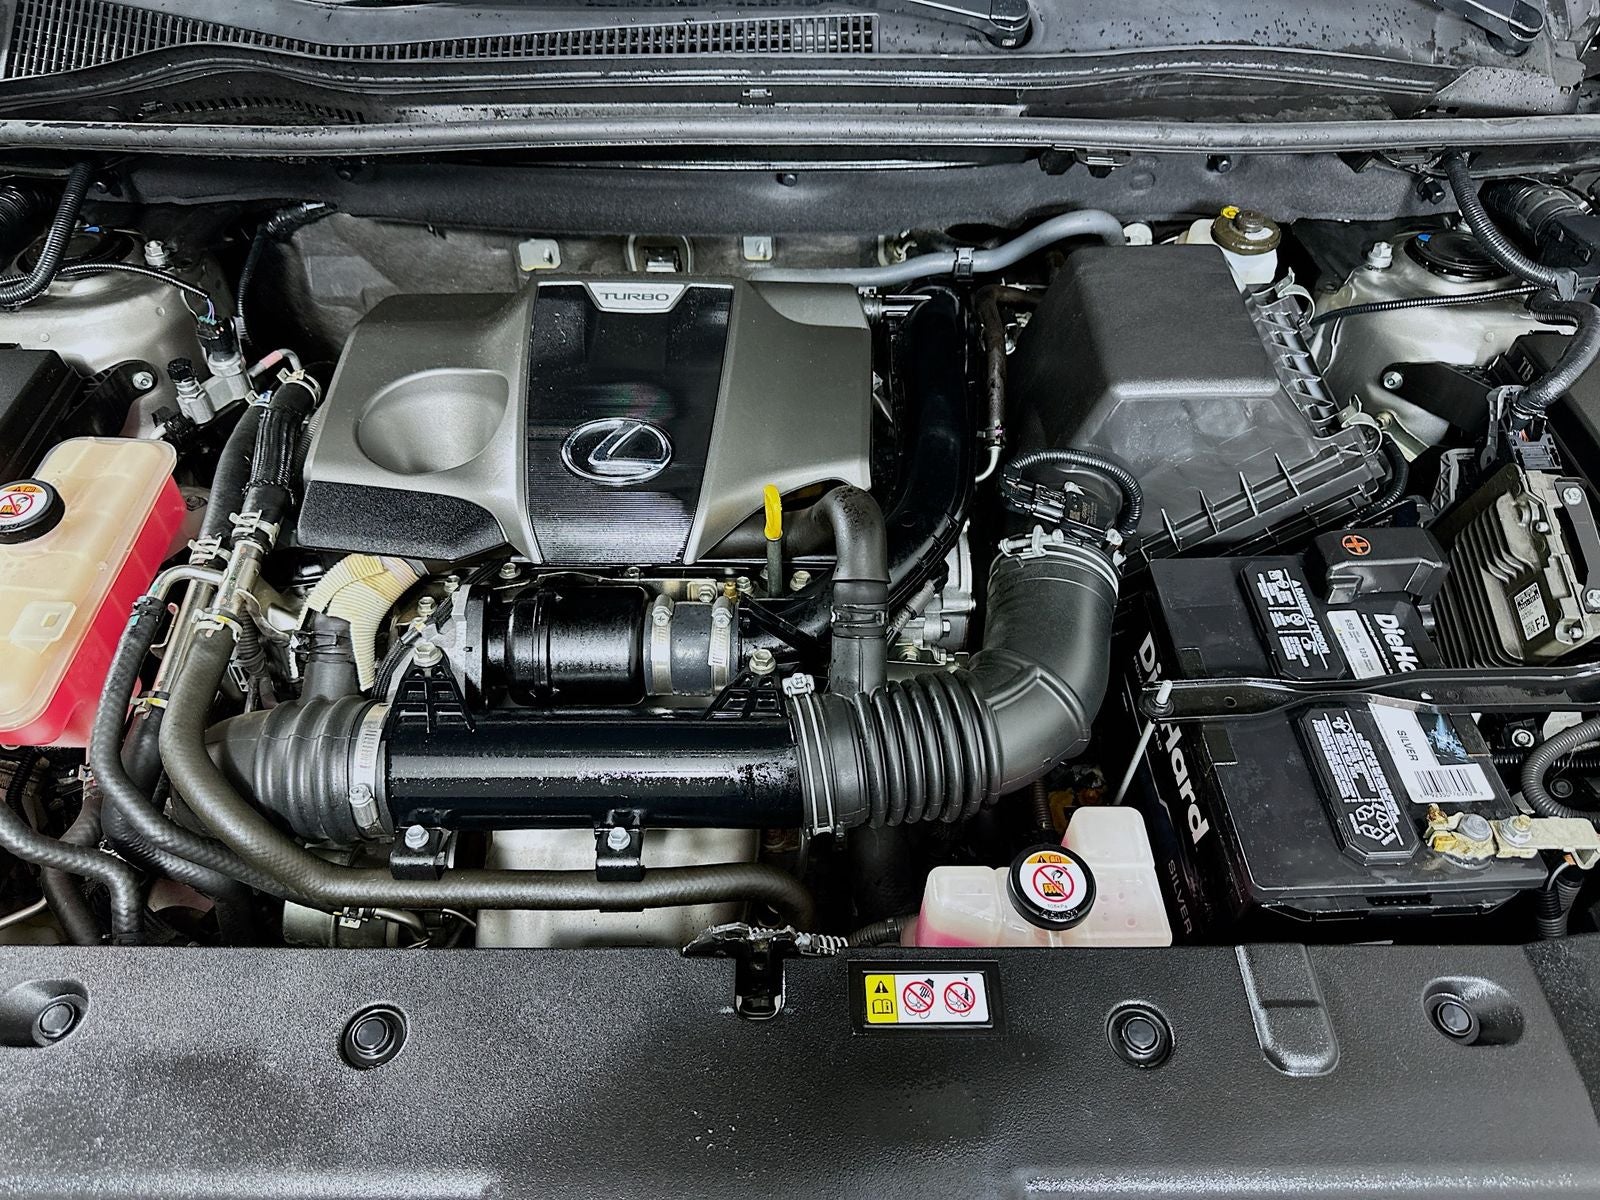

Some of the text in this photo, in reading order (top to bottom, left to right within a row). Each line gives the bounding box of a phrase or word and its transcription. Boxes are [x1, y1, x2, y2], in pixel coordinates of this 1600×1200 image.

[599, 292, 670, 302] TURBO
[1534, 614, 1549, 631] F2
[1396, 729, 1419, 762] SILVER
[1169, 859, 1193, 934] SILVER
